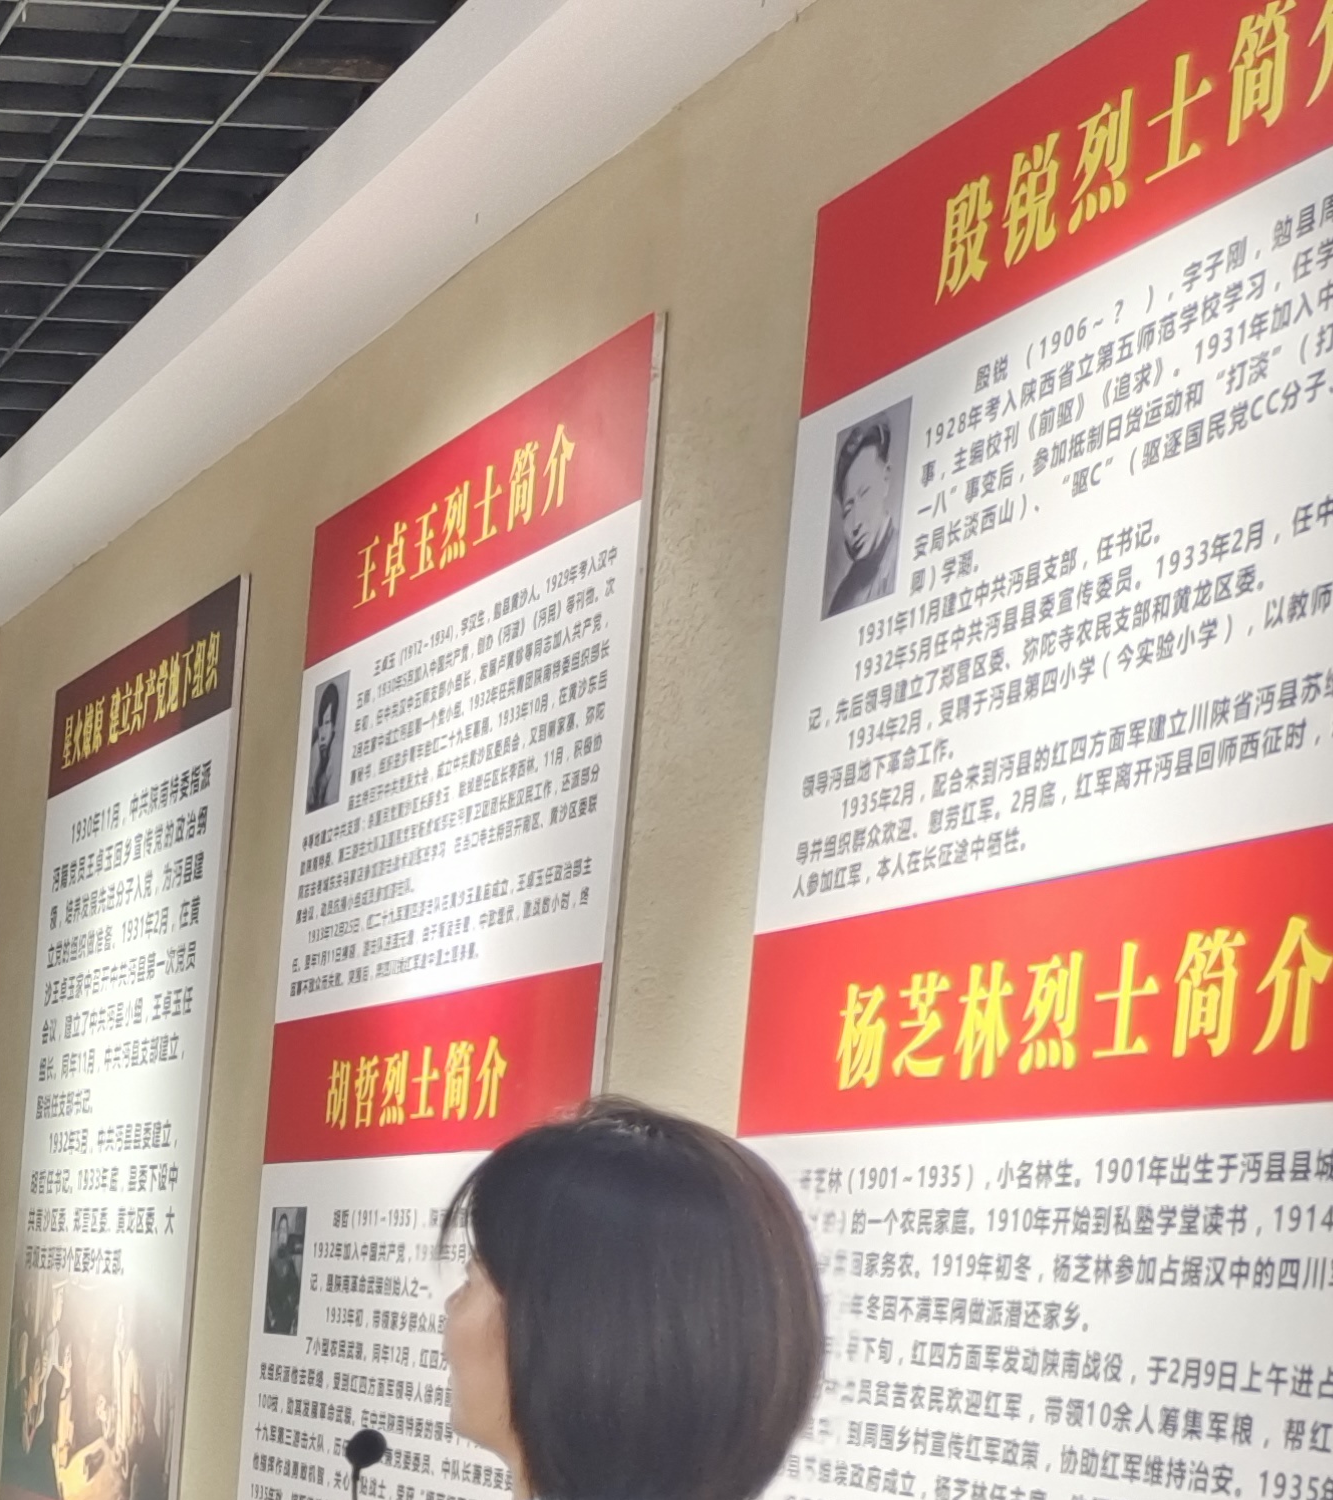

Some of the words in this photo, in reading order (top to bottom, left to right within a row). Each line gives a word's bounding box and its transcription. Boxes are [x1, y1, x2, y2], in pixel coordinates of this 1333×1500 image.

[351, 422, 576, 610] 王卓玉烈士简介
[324, 1035, 508, 1130] 胡哲烈士简介
[836, 915, 1333, 1091] 杨芝林烈士简介
